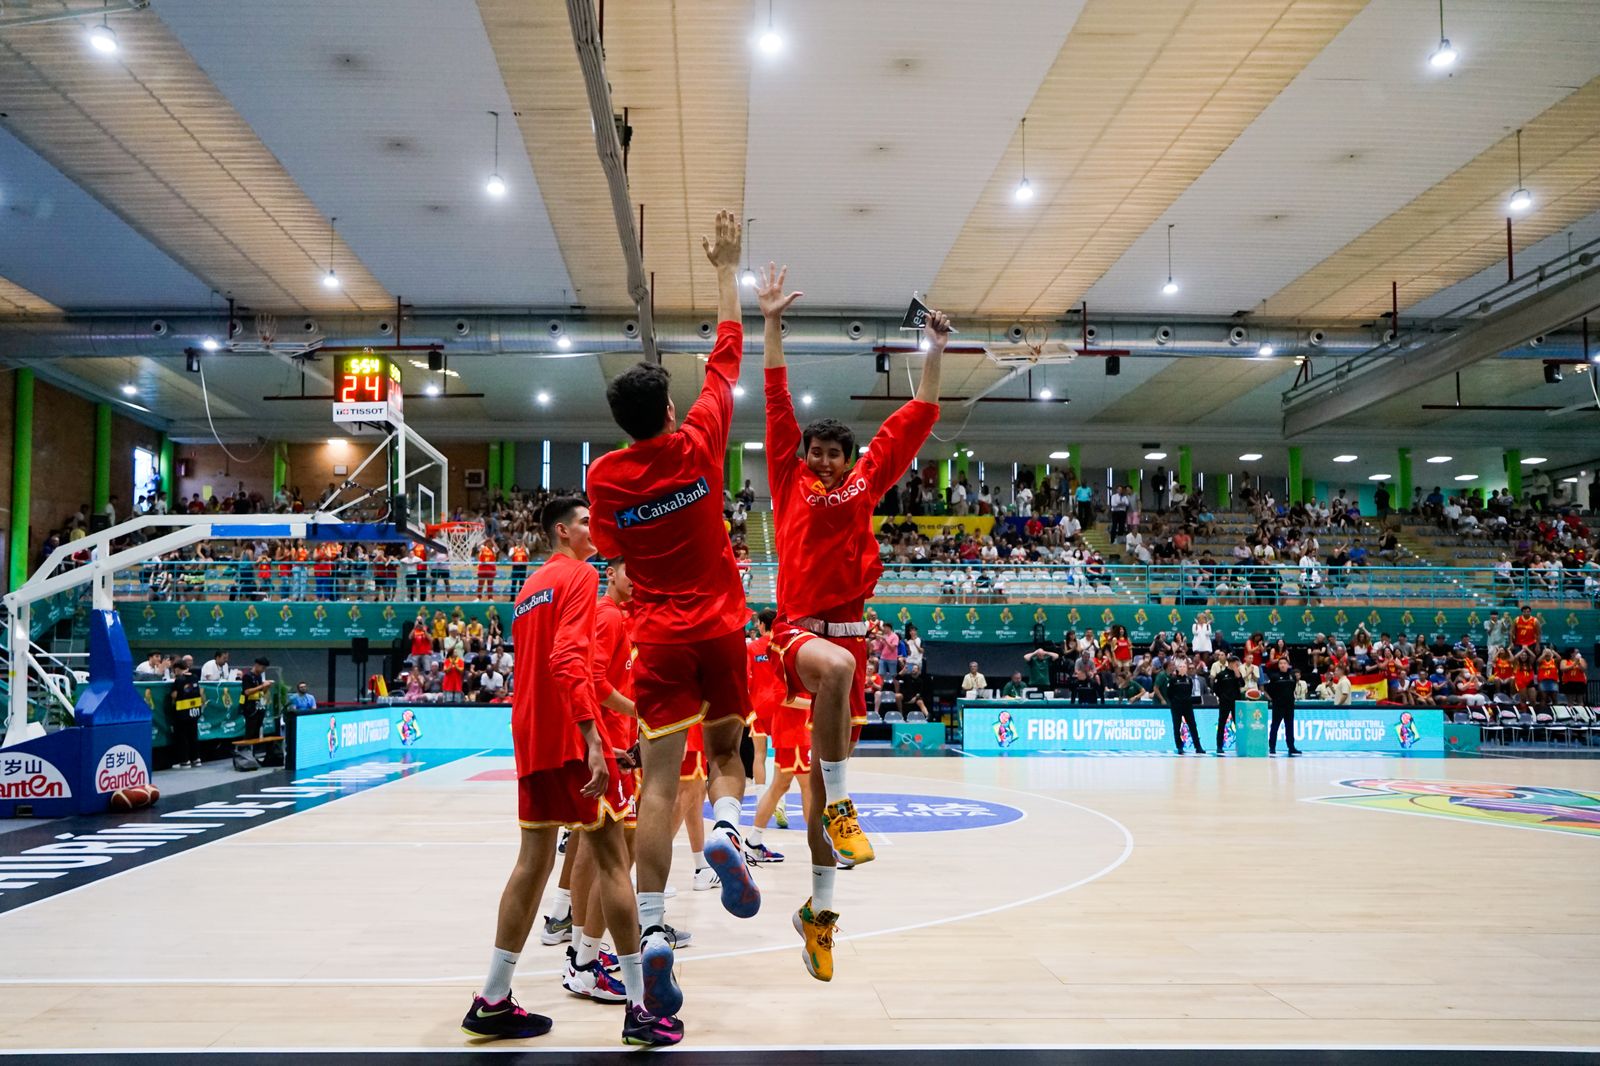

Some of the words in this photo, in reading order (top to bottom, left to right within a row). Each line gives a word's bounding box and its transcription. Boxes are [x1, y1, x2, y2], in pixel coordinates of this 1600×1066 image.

[342, 375, 380, 402] 24
[637, 482, 707, 520] CaixaBank
[806, 477, 867, 508] endesa
[1027, 719, 1068, 740] FIBA
[1072, 719, 1104, 740] U17
[1104, 720, 1125, 728] MEN'S
[1126, 720, 1166, 728] BASKETBALL
[1324, 720, 1344, 728] MEN'S
[1345, 720, 1385, 728] BASKETBALL
[341, 722, 358, 748] FIBA
[358, 720, 371, 745] U17
[1104, 728, 1141, 740] WORLD
[1143, 728, 1166, 740] CUP
[1324, 729, 1361, 741] WORLD
[1365, 729, 1386, 741] CUP
[0, 759, 42, 776] 岁山
[105, 751, 136, 769] 百岁山
[160, 800, 297, 819] DE
[236, 785, 347, 799] LA
